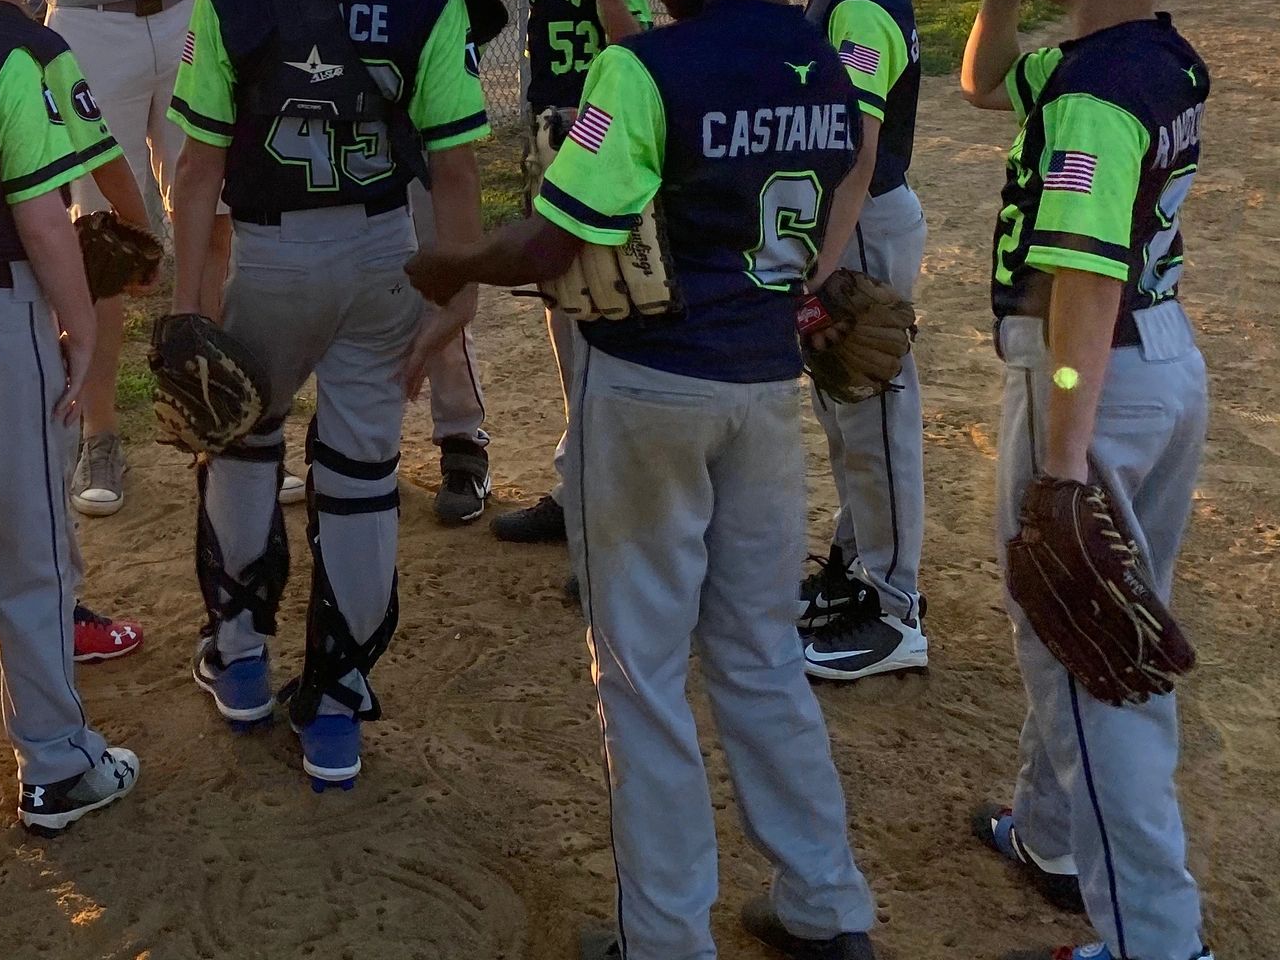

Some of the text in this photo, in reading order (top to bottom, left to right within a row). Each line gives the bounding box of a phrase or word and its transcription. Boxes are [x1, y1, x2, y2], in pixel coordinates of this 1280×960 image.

[338, 2, 388, 44] CE
[548, 19, 600, 76] 53
[702, 104, 854, 158] CASTANE
[742, 170, 823, 292] 6
